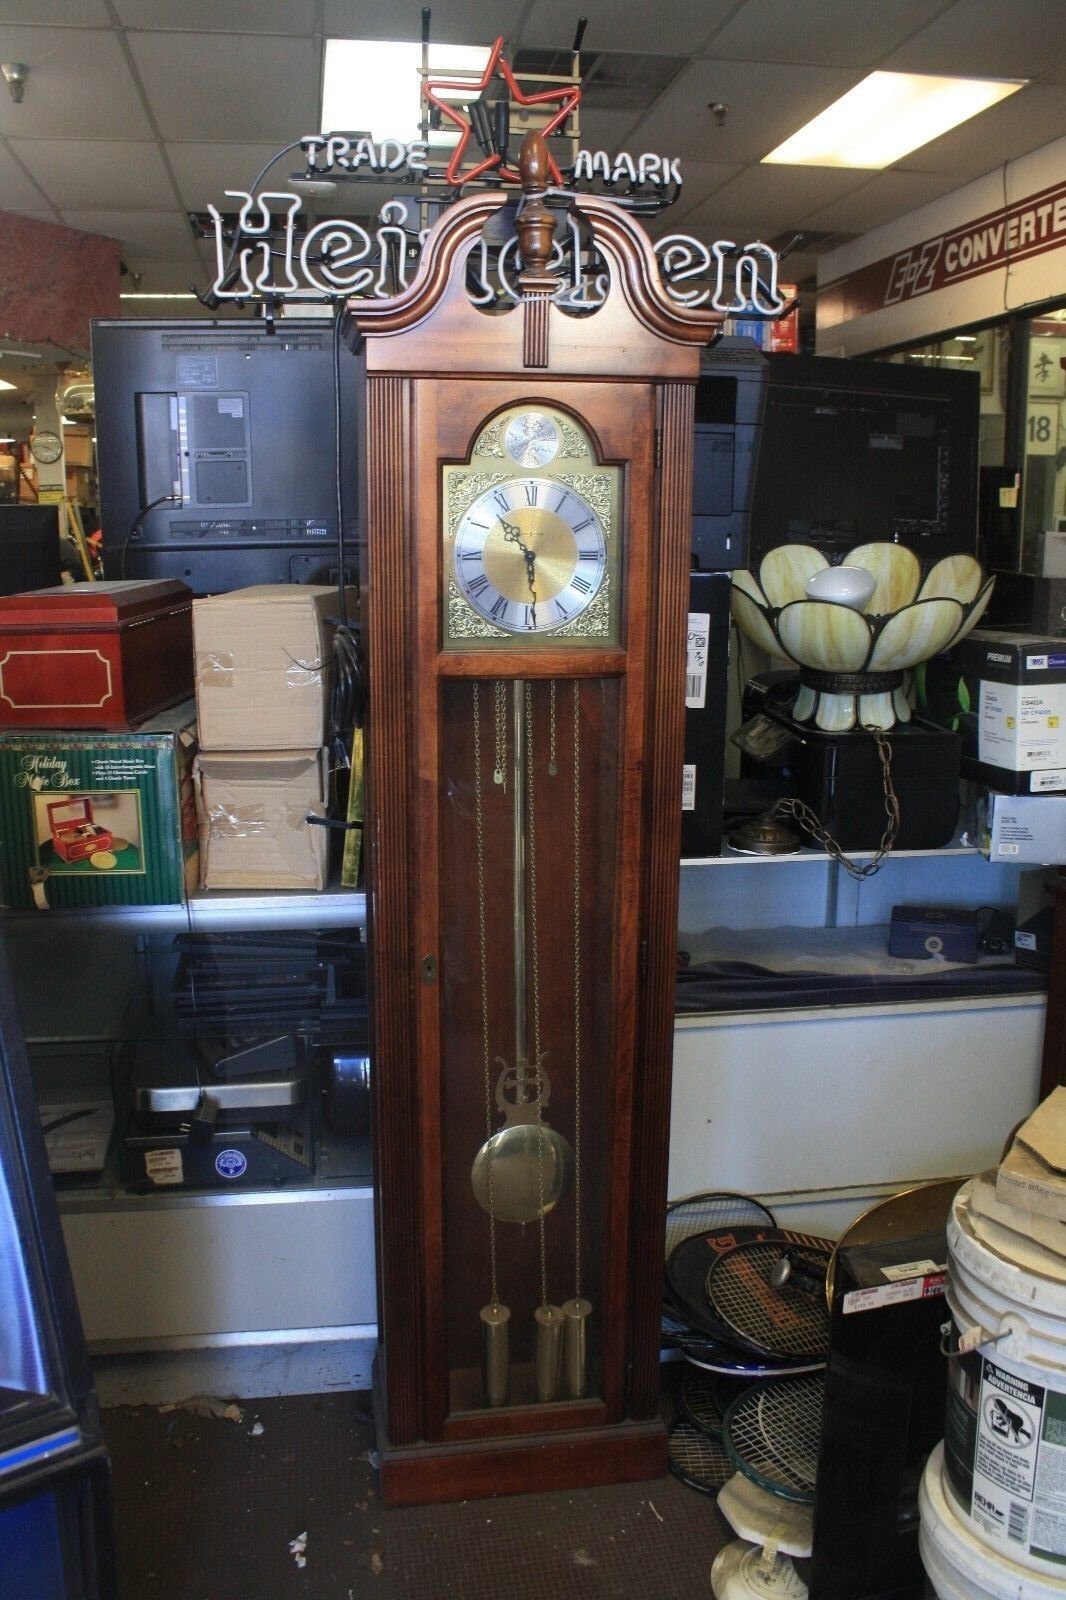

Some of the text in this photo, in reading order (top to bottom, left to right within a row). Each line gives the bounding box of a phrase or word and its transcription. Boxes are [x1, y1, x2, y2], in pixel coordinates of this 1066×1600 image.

[301, 135, 682, 185] TRADE MARK
[945, 197, 1066, 273] CONVERTE
[1028, 416, 1050, 442] 18
[21, 755, 67, 772] Holiday
[51, 771, 80, 787] Box
[987, 1374, 1036, 1404] ADVERTENCIA
[996, 1367, 1029, 1391] WARNING
